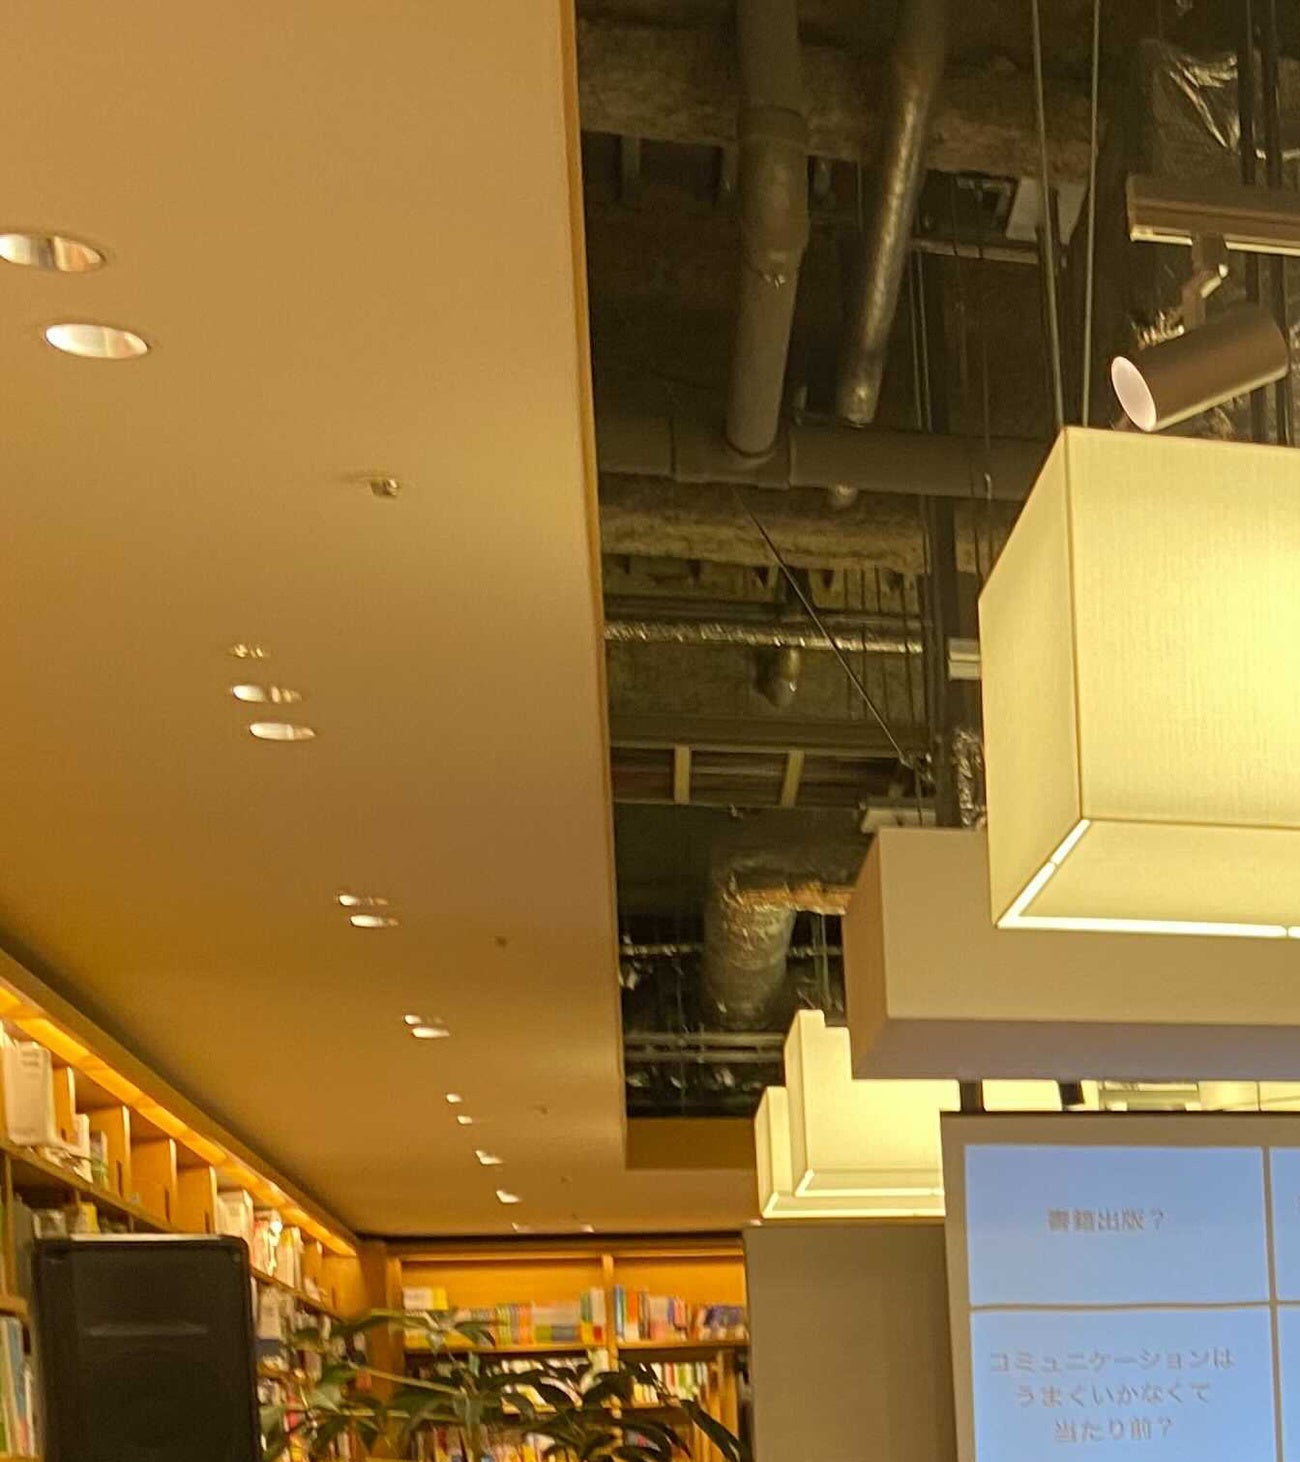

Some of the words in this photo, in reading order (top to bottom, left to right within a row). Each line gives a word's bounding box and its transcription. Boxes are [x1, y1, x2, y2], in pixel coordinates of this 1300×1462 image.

[990, 1348, 1234, 1373] コミュニケーションは
[1017, 1381, 1211, 1408] うまくいかなくて
[1054, 1416, 1174, 1443] 当たり前？
